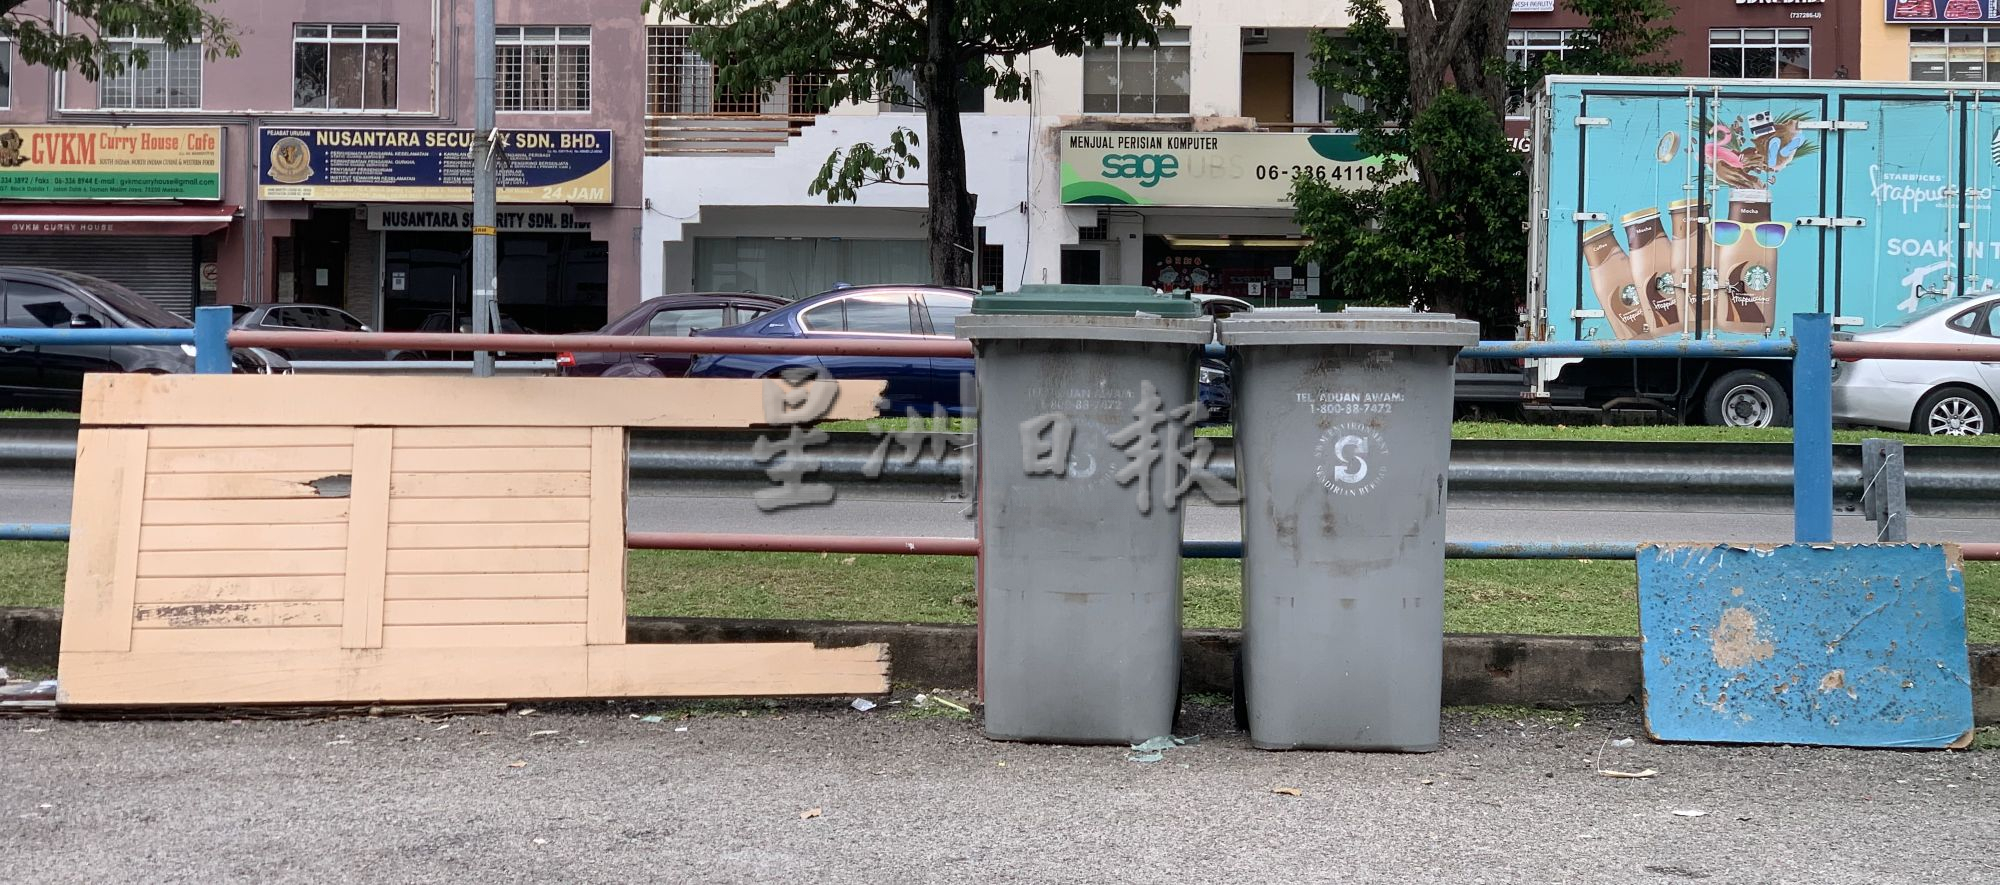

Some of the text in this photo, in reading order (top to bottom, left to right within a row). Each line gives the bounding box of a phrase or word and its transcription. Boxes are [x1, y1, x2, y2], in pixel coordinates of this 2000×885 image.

[31, 133, 96, 165] GVKM
[100, 133, 137, 154] Curry
[141, 133, 178, 151] House
[188, 133, 215, 151] Cafe
[316, 131, 421, 147] NUSANTARA
[516, 134, 555, 150] SDN.
[560, 134, 601, 150] BHD.
[1070, 135, 1218, 151] MENJUAL PERISIAN KOMPUTER
[1101, 153, 1179, 188] sage
[1331, 166, 1377, 181] 4118
[1883, 173, 1942, 182] STARBUCKS
[543, 186, 561, 199] 24
[567, 187, 604, 200] JAM
[12, 223, 114, 232] GVKM CURRY HOUSE
[382, 211, 458, 228] NUSANTARA
[528, 213, 557, 229] SDN.
[1888, 238, 1954, 258] SOAK
[1320, 393, 1360, 403] ADUAN
[1364, 393, 1405, 403] AWAM:
[1311, 404, 1392, 414] 1-800-88-7472
[1328, 422, 1389, 456] ENVIRONMENT
[1315, 465, 1356, 497] SENDIRIAN
